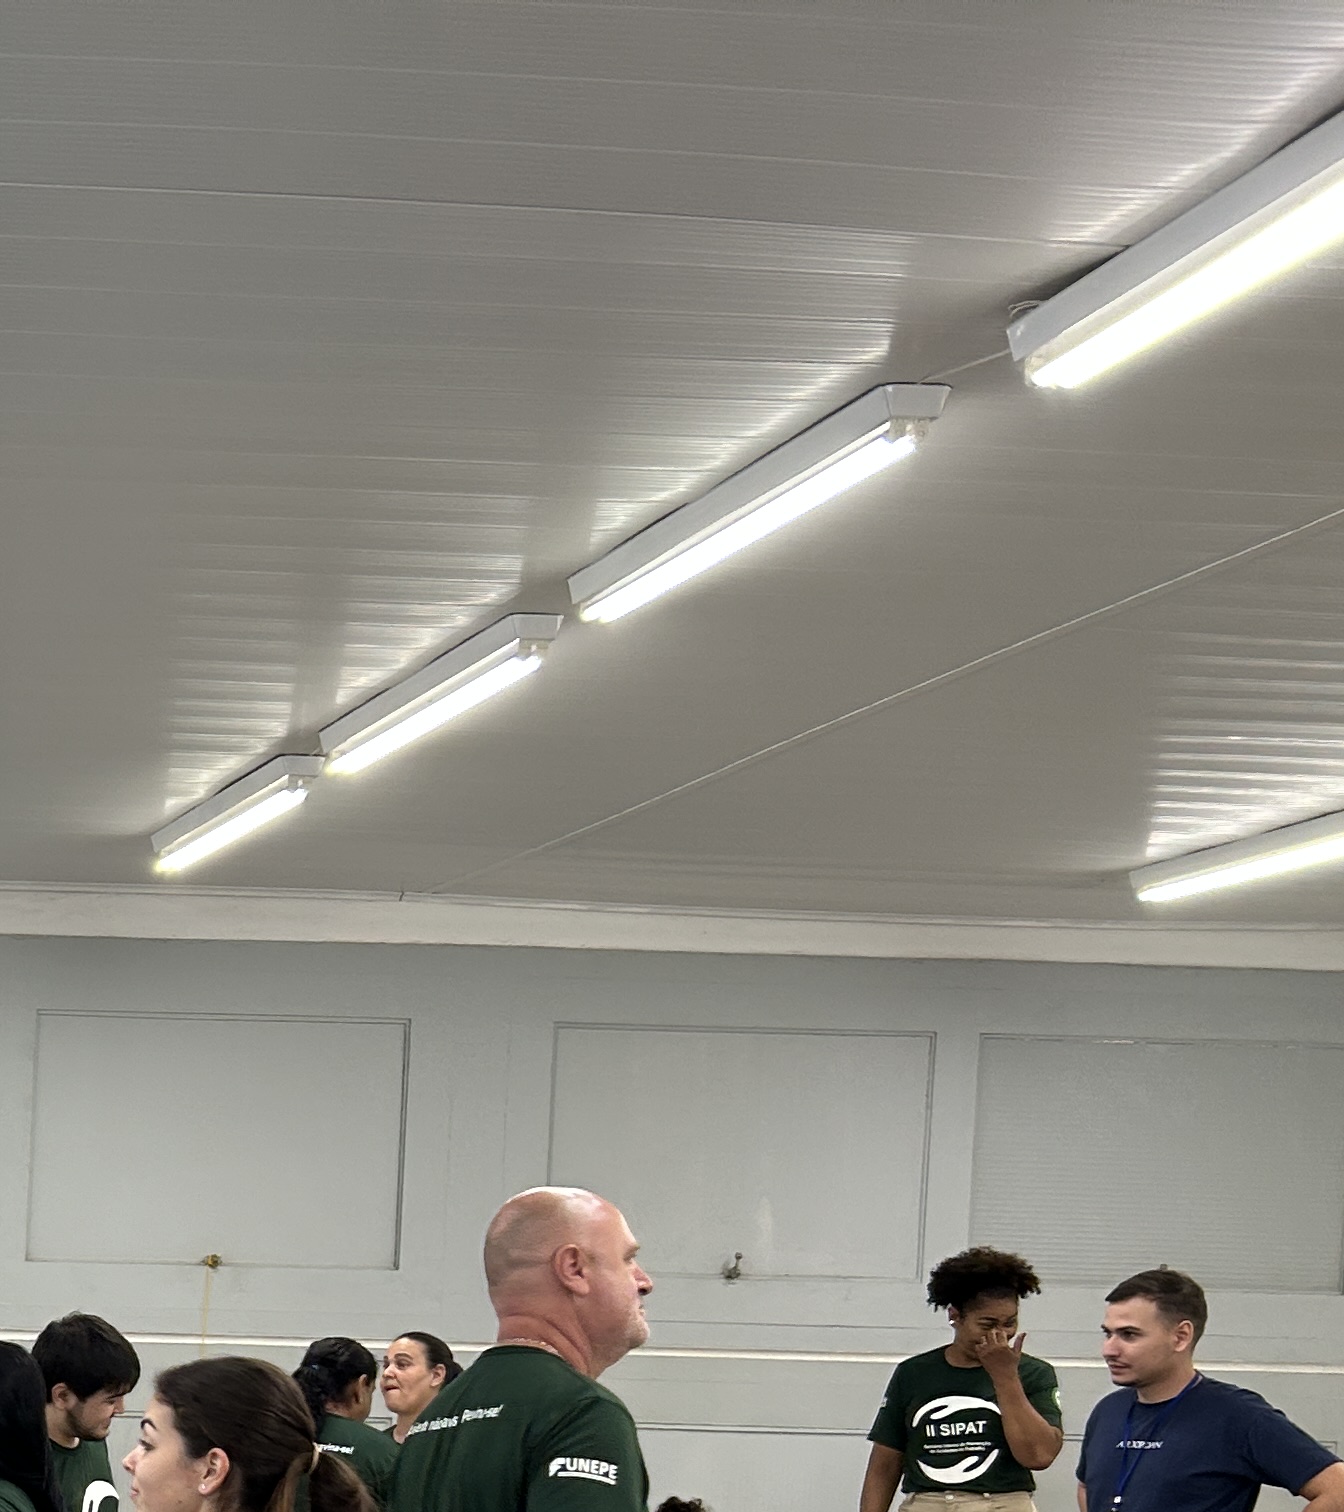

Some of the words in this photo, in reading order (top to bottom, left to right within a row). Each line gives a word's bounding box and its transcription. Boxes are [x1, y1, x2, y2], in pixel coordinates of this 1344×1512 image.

[925, 1424, 936, 1437] II
[939, 1420, 987, 1437] SIPAT
[548, 1457, 618, 1480] FUNEPE
